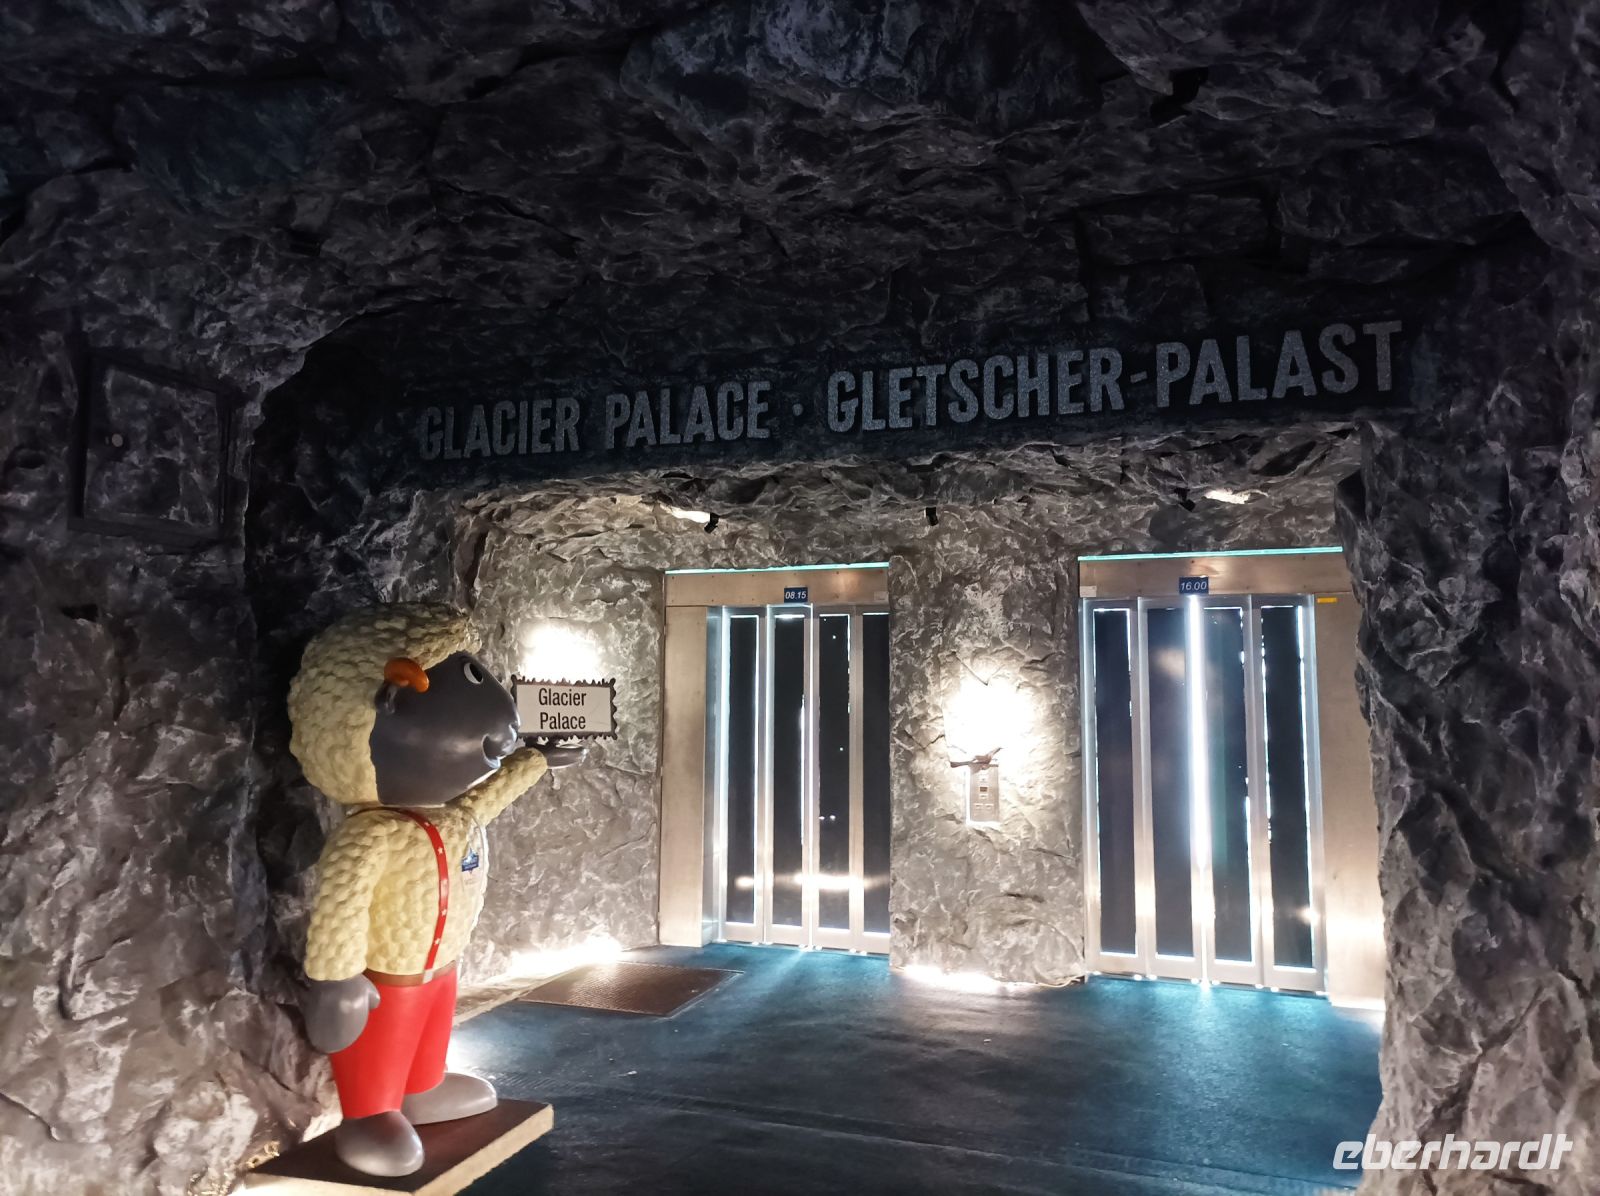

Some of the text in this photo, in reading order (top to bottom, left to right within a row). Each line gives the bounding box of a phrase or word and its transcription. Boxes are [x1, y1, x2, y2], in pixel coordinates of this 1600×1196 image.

[419, 397, 580, 460] GLACIER
[605, 380, 771, 449] PALACE
[827, 320, 1402, 433] GLETSCHER-PALAST
[538, 687, 587, 706] Glacier
[540, 712, 586, 730] Palace
